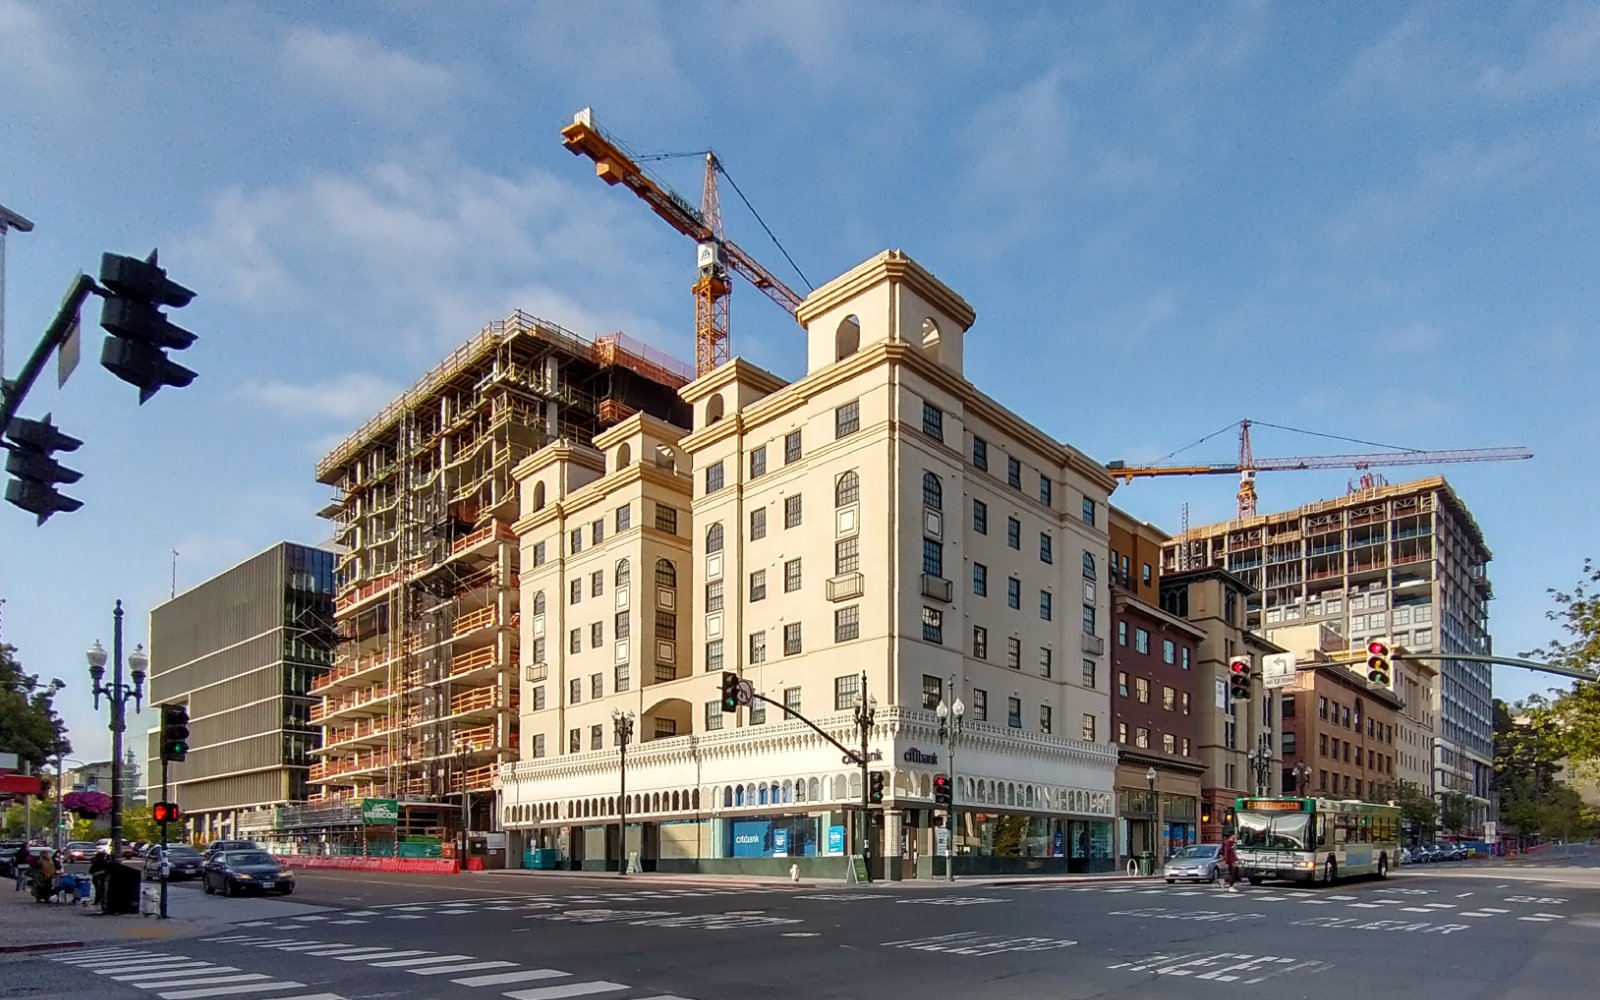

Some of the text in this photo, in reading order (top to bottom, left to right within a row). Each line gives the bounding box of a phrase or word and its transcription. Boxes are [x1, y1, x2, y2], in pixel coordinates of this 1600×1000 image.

[904, 747, 938, 765] citibank
[363, 811, 398, 819] WEBCOR
[735, 834, 760, 844] citibank
[1290, 917, 1471, 935] CLEAR
[879, 930, 1079, 956] KEEP
